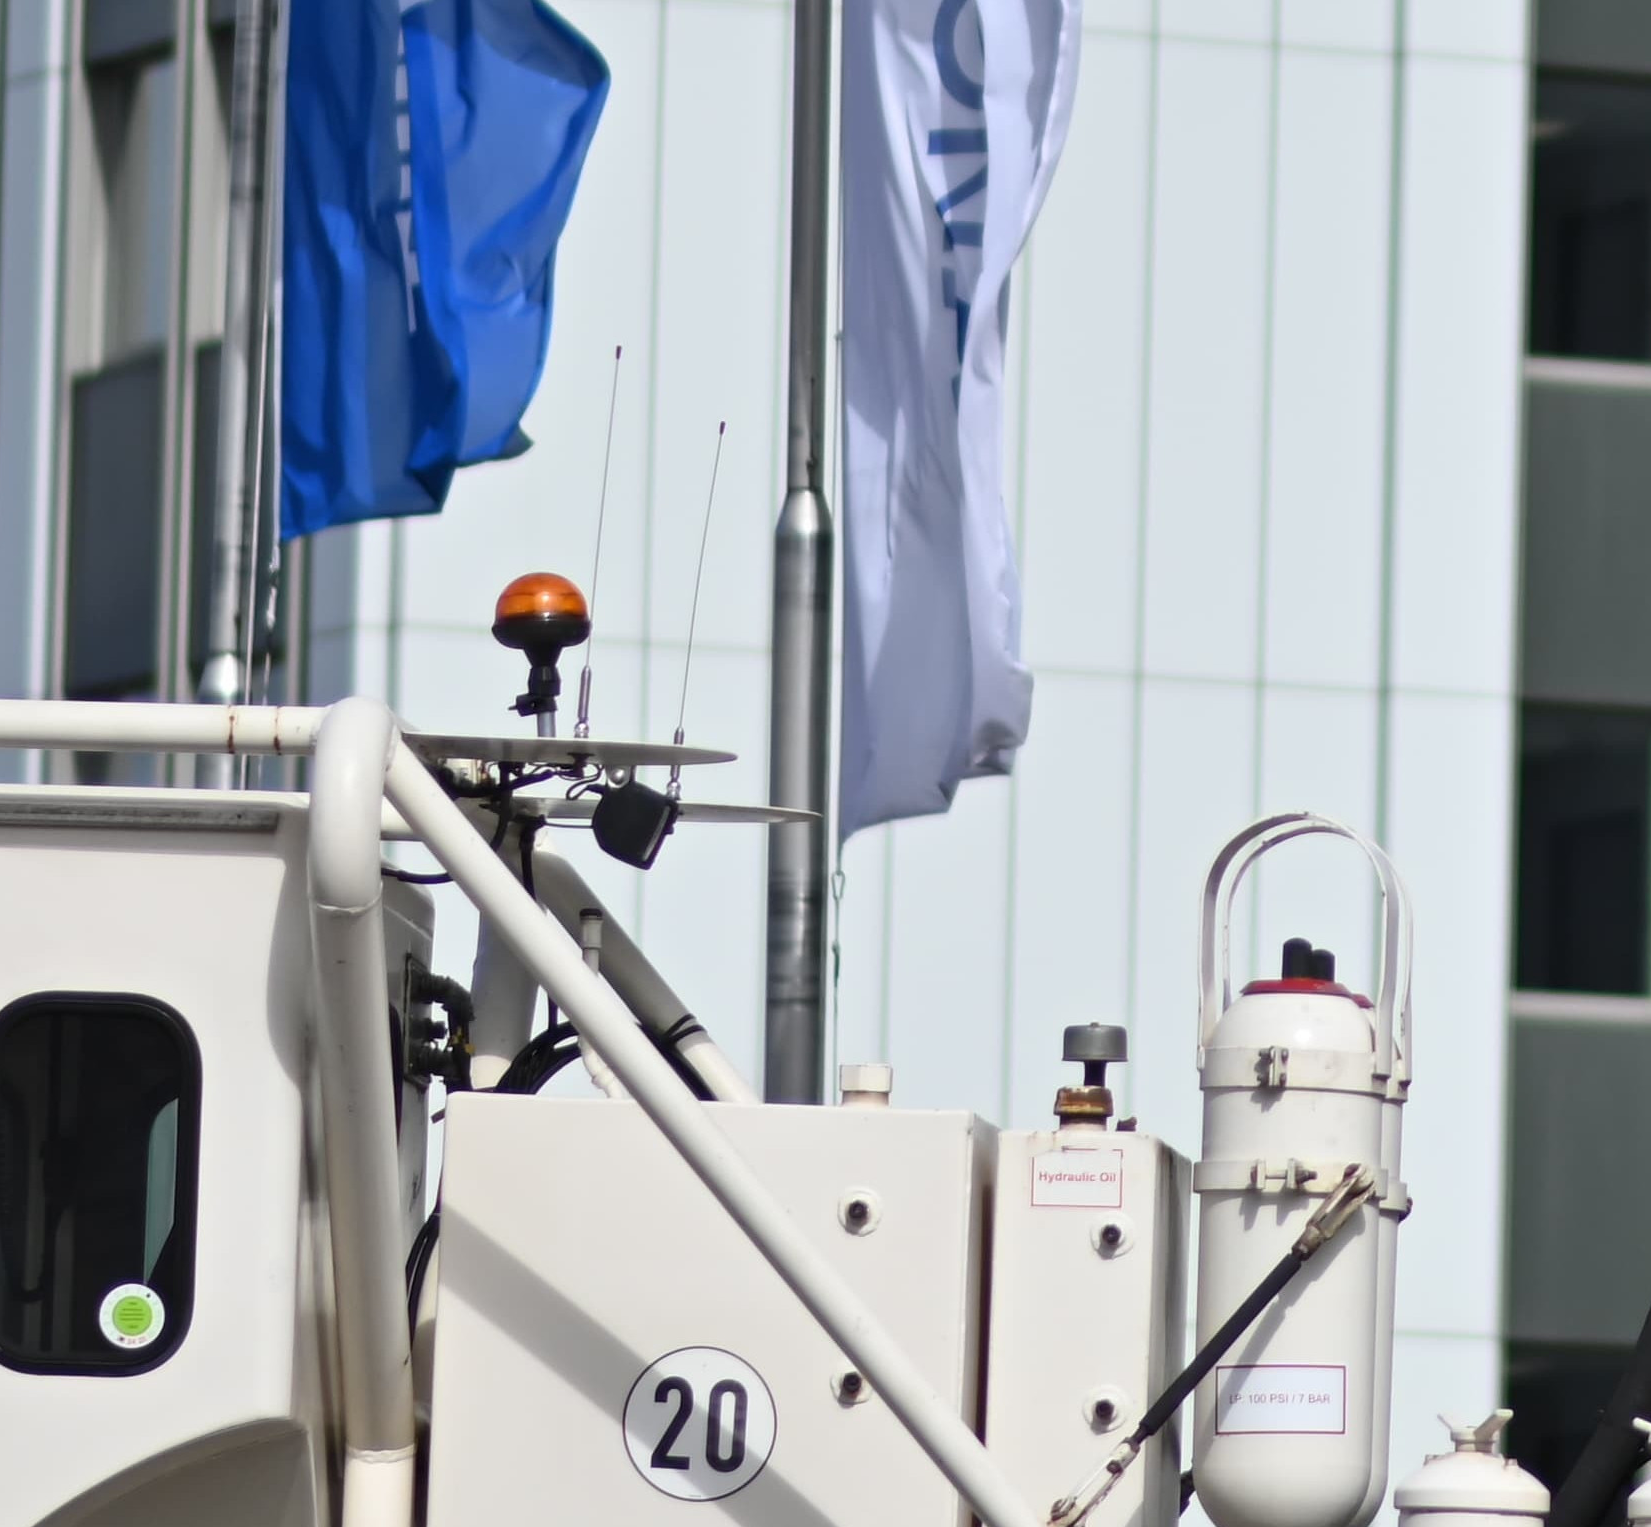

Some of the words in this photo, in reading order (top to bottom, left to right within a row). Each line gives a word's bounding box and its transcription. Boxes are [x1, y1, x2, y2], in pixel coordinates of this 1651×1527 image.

[1038, 1171, 1096, 1184] Hydraulic
[1099, 1172, 1116, 1182] Oil
[1248, 1394, 1267, 1404] 100
[1269, 1394, 1289, 1404] PSI
[1308, 1394, 1331, 1404] BAR
[650, 1376, 749, 1472] 20
